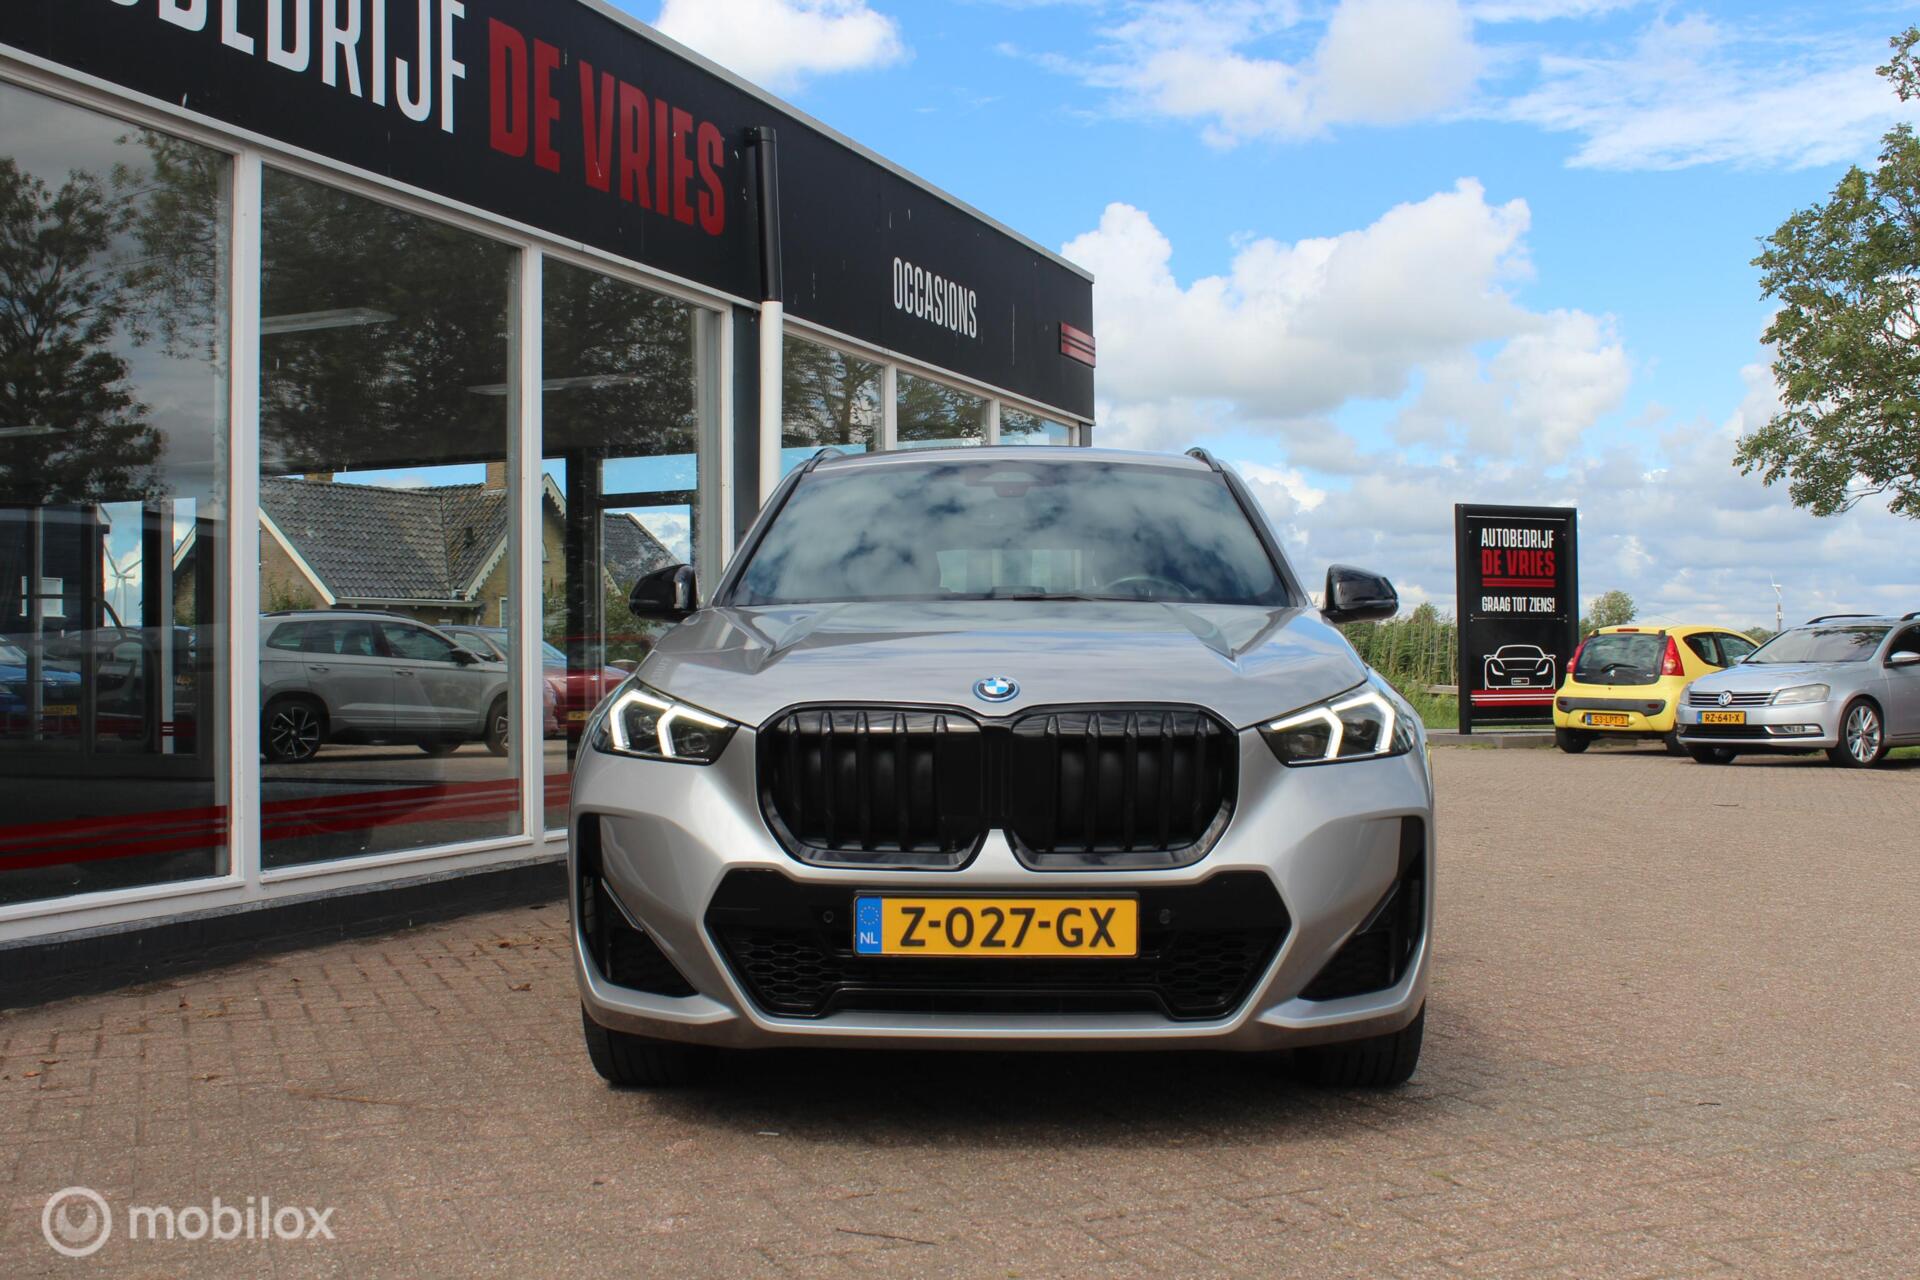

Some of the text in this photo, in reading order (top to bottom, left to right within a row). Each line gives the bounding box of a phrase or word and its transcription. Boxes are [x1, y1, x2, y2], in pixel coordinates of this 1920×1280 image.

[110, 0, 726, 236] DRIJF DE VRIES
[893, 256, 977, 338] OCCASIONS
[1481, 528, 1554, 549] AUTOBEDRIJF
[1482, 549, 1555, 577] DE VRIES
[1481, 596, 1556, 613] GRAAG TOT ZIENS!
[1704, 712, 1741, 723] RZ-641-X
[859, 906, 1116, 948] NL Z-027-GX
